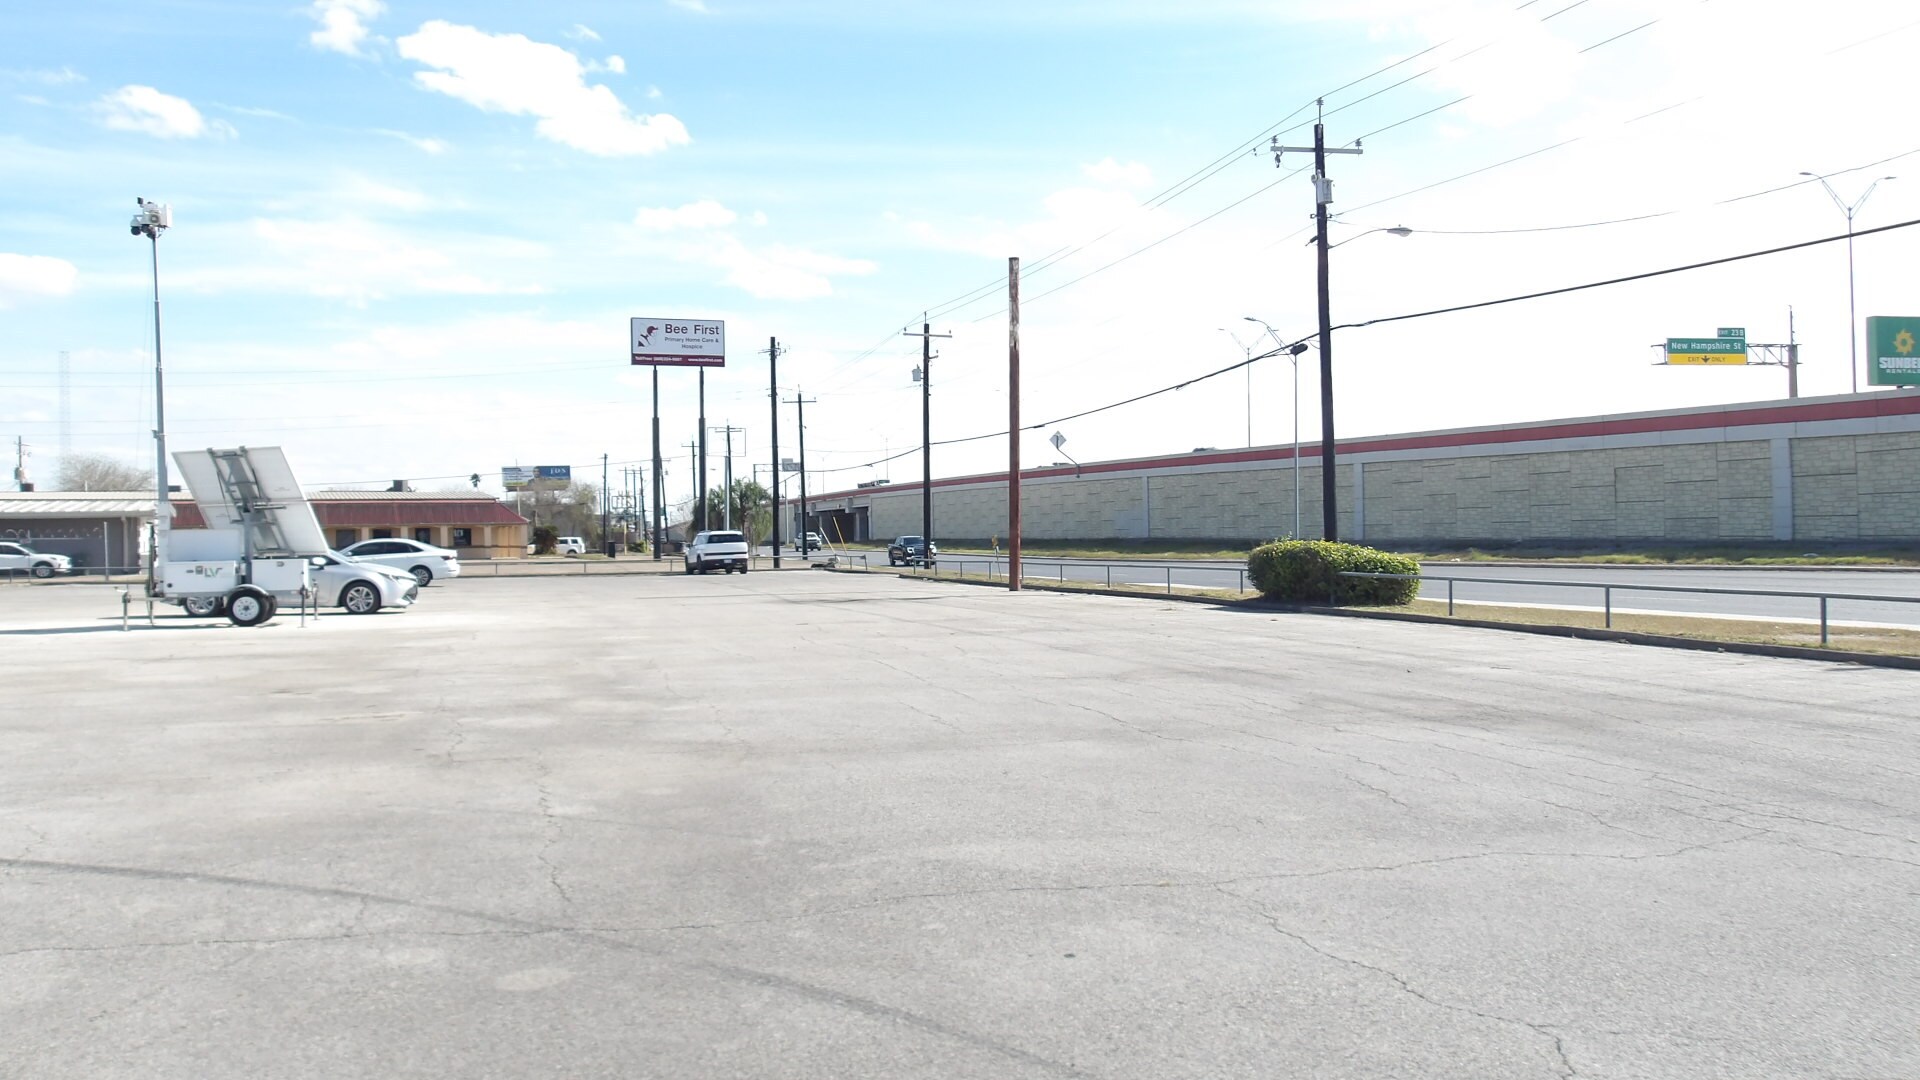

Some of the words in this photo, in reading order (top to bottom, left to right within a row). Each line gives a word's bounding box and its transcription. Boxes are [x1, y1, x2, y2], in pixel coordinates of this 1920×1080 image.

[665, 323, 688, 334] Bee
[694, 324, 720, 335] First
[1671, 342, 1688, 350] New
[1690, 342, 1731, 351] Hampshire
[1733, 342, 1741, 350] St
[1879, 357, 1920, 369] SUNBE
